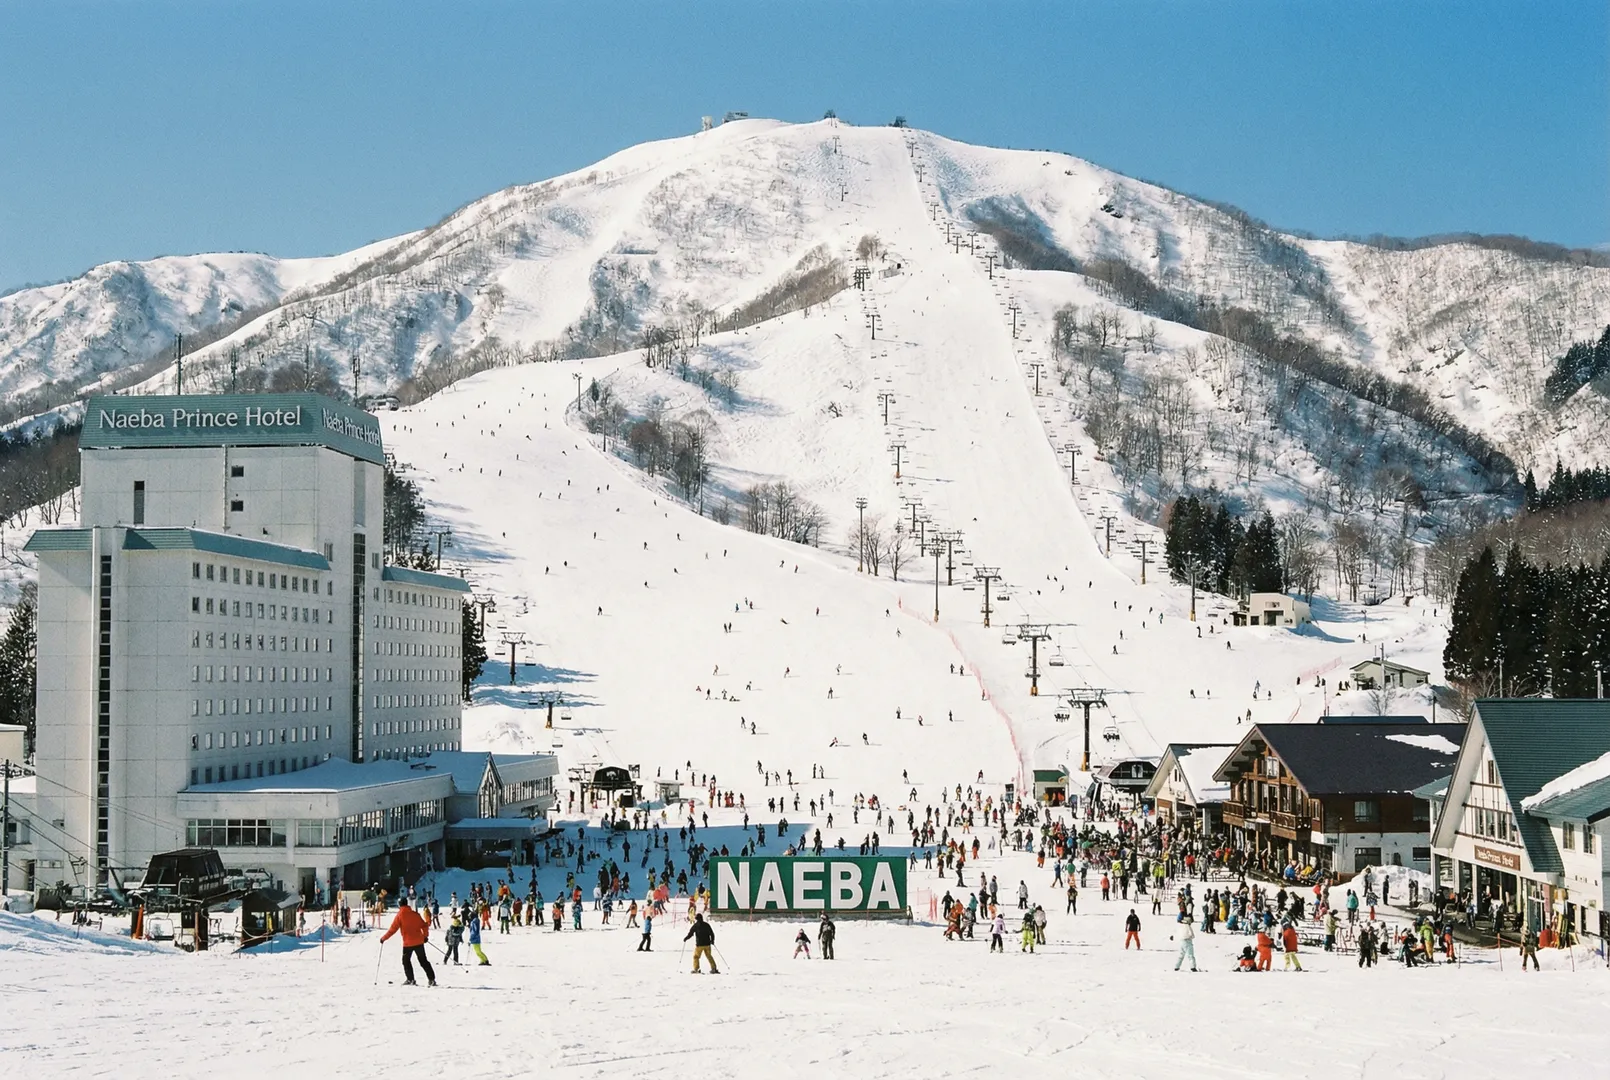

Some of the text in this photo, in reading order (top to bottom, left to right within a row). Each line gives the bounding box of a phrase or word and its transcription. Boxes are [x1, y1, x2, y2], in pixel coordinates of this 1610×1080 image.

[99, 405, 301, 429] Naeba Prince Hotel
[717, 861, 900, 910] NAEBA
